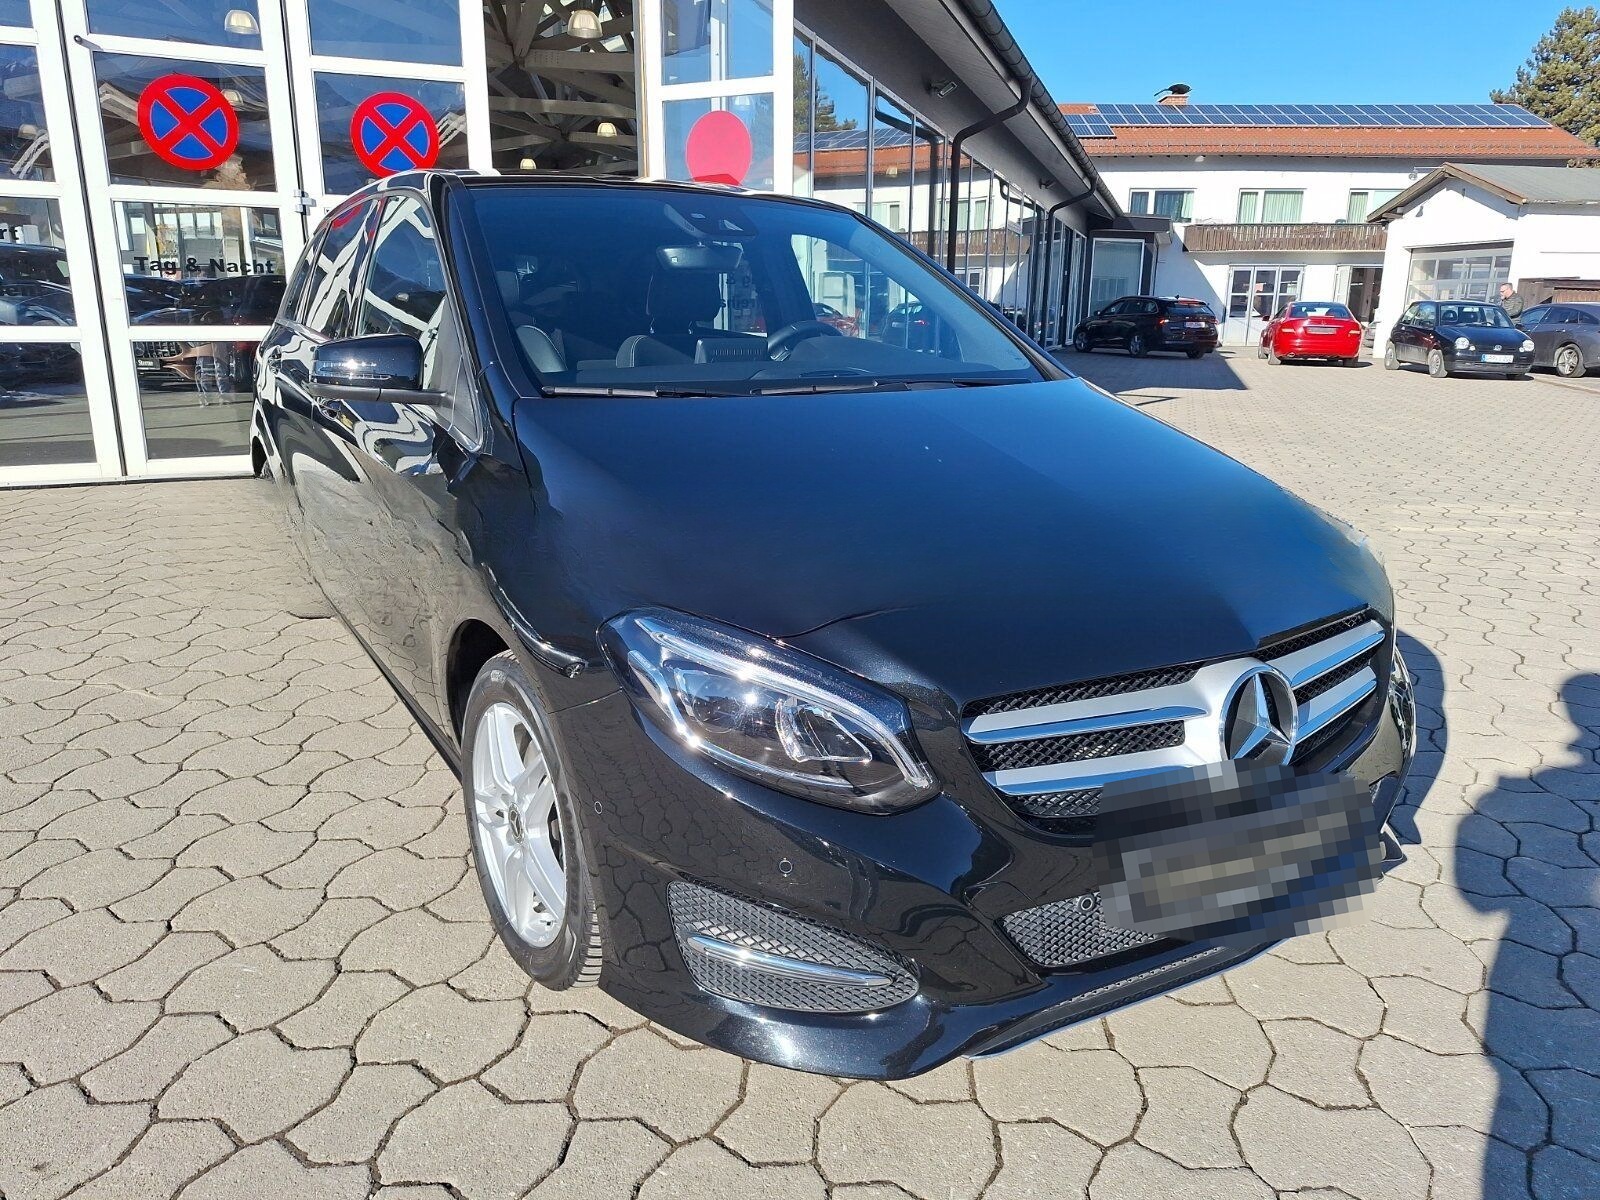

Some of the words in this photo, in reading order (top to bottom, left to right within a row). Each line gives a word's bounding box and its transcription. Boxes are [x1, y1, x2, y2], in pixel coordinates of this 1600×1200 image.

[133, 256, 177, 275] Tag
[186, 257, 201, 273] &
[209, 257, 275, 274] Nacht
